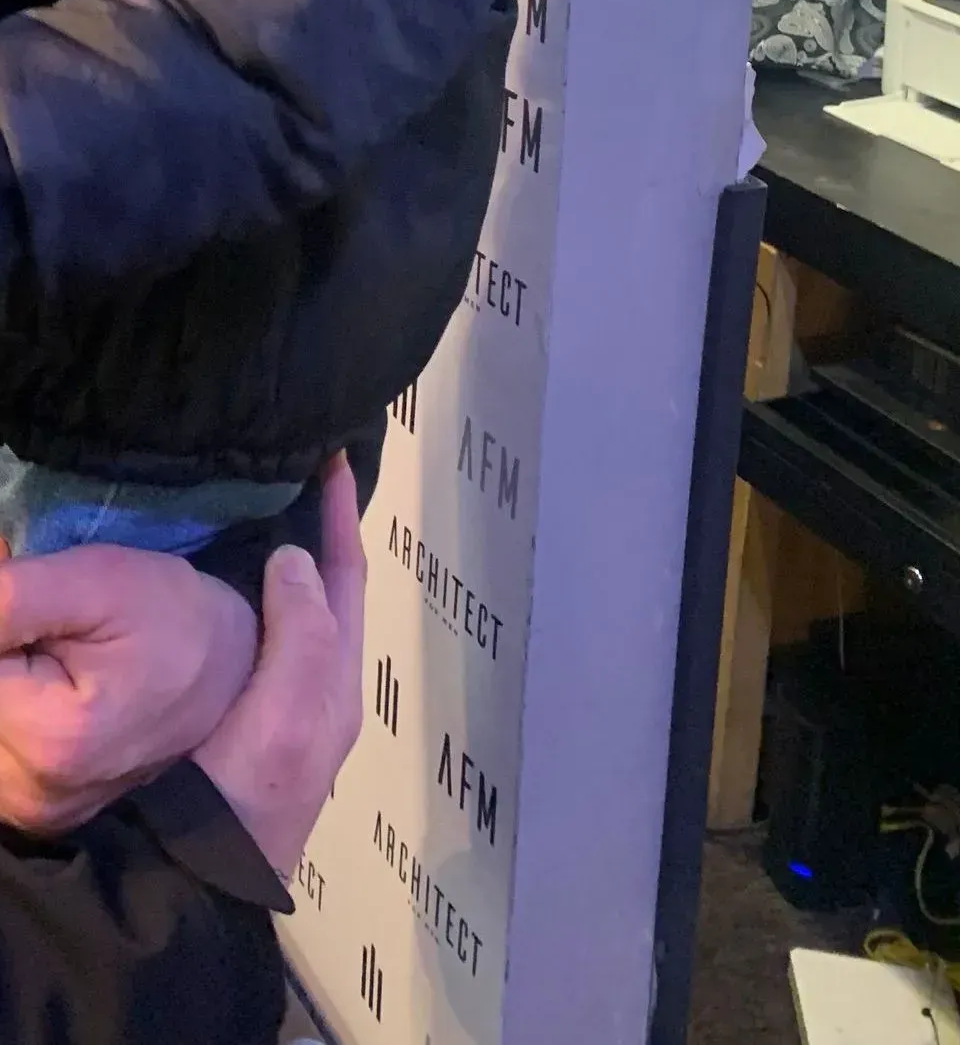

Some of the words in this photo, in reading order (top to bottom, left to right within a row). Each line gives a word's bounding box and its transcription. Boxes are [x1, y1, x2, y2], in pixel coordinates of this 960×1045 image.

[457, 417, 520, 520] AFM
[389, 515, 503, 660] ARCHITECT
[437, 732, 498, 846] AFM
[373, 810, 483, 977] ARCHITECT
